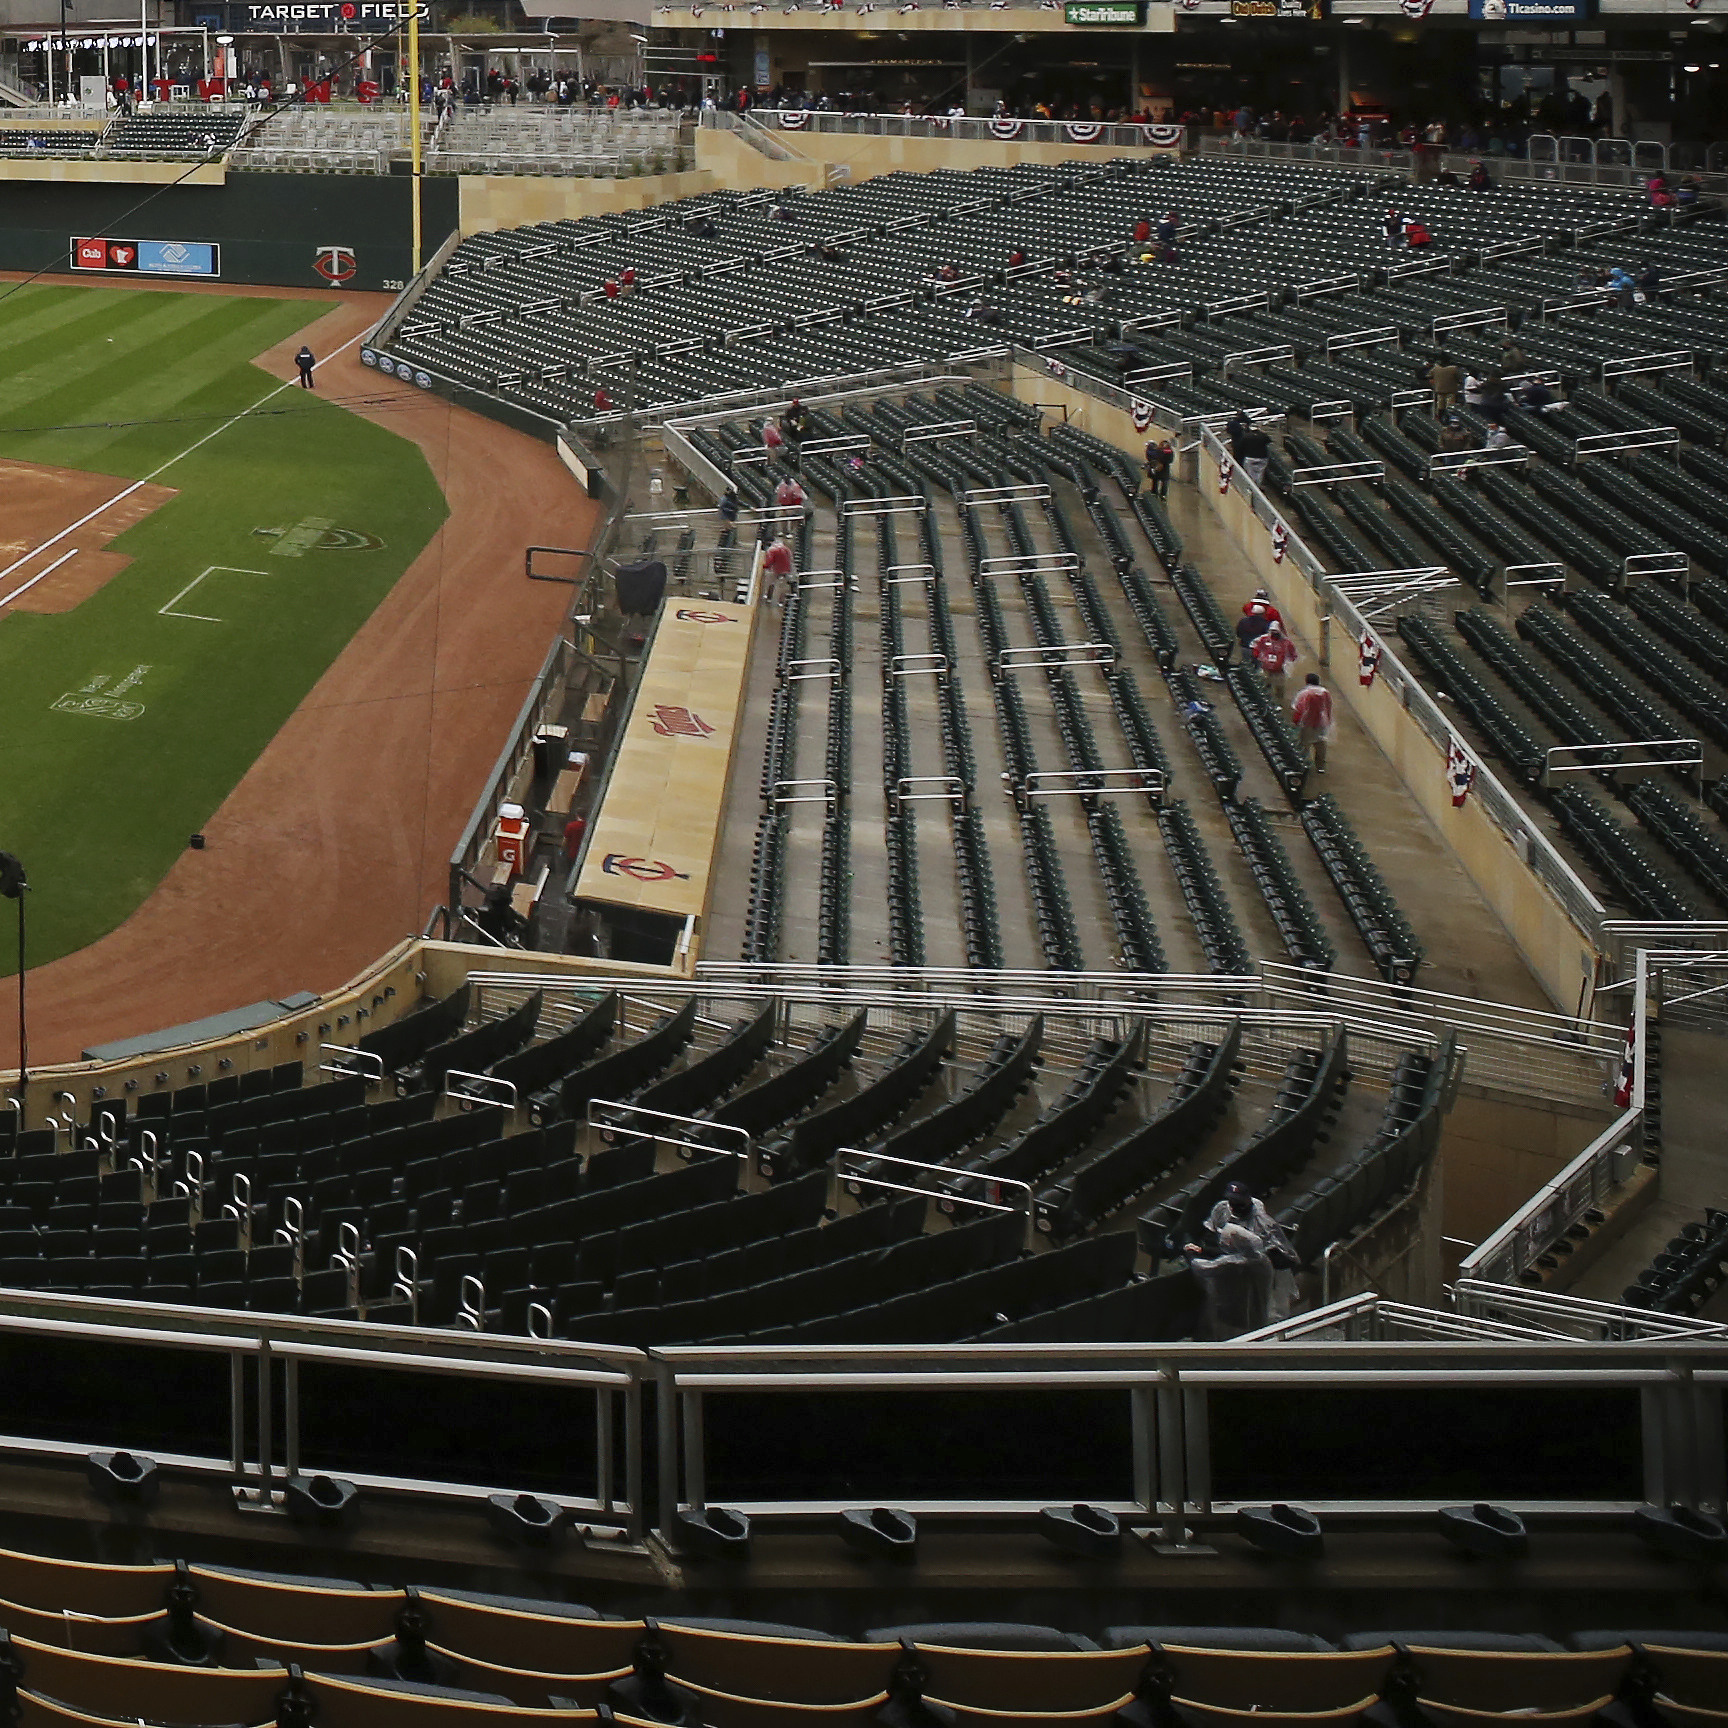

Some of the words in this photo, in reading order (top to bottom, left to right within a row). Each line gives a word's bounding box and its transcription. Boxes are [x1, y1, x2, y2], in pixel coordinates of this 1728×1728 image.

[249, 3, 334, 19] TARGET
[361, 3, 430, 18] FIELD
[1079, 7, 1136, 22] StarTribune
[82, 248, 101, 259] Cub
